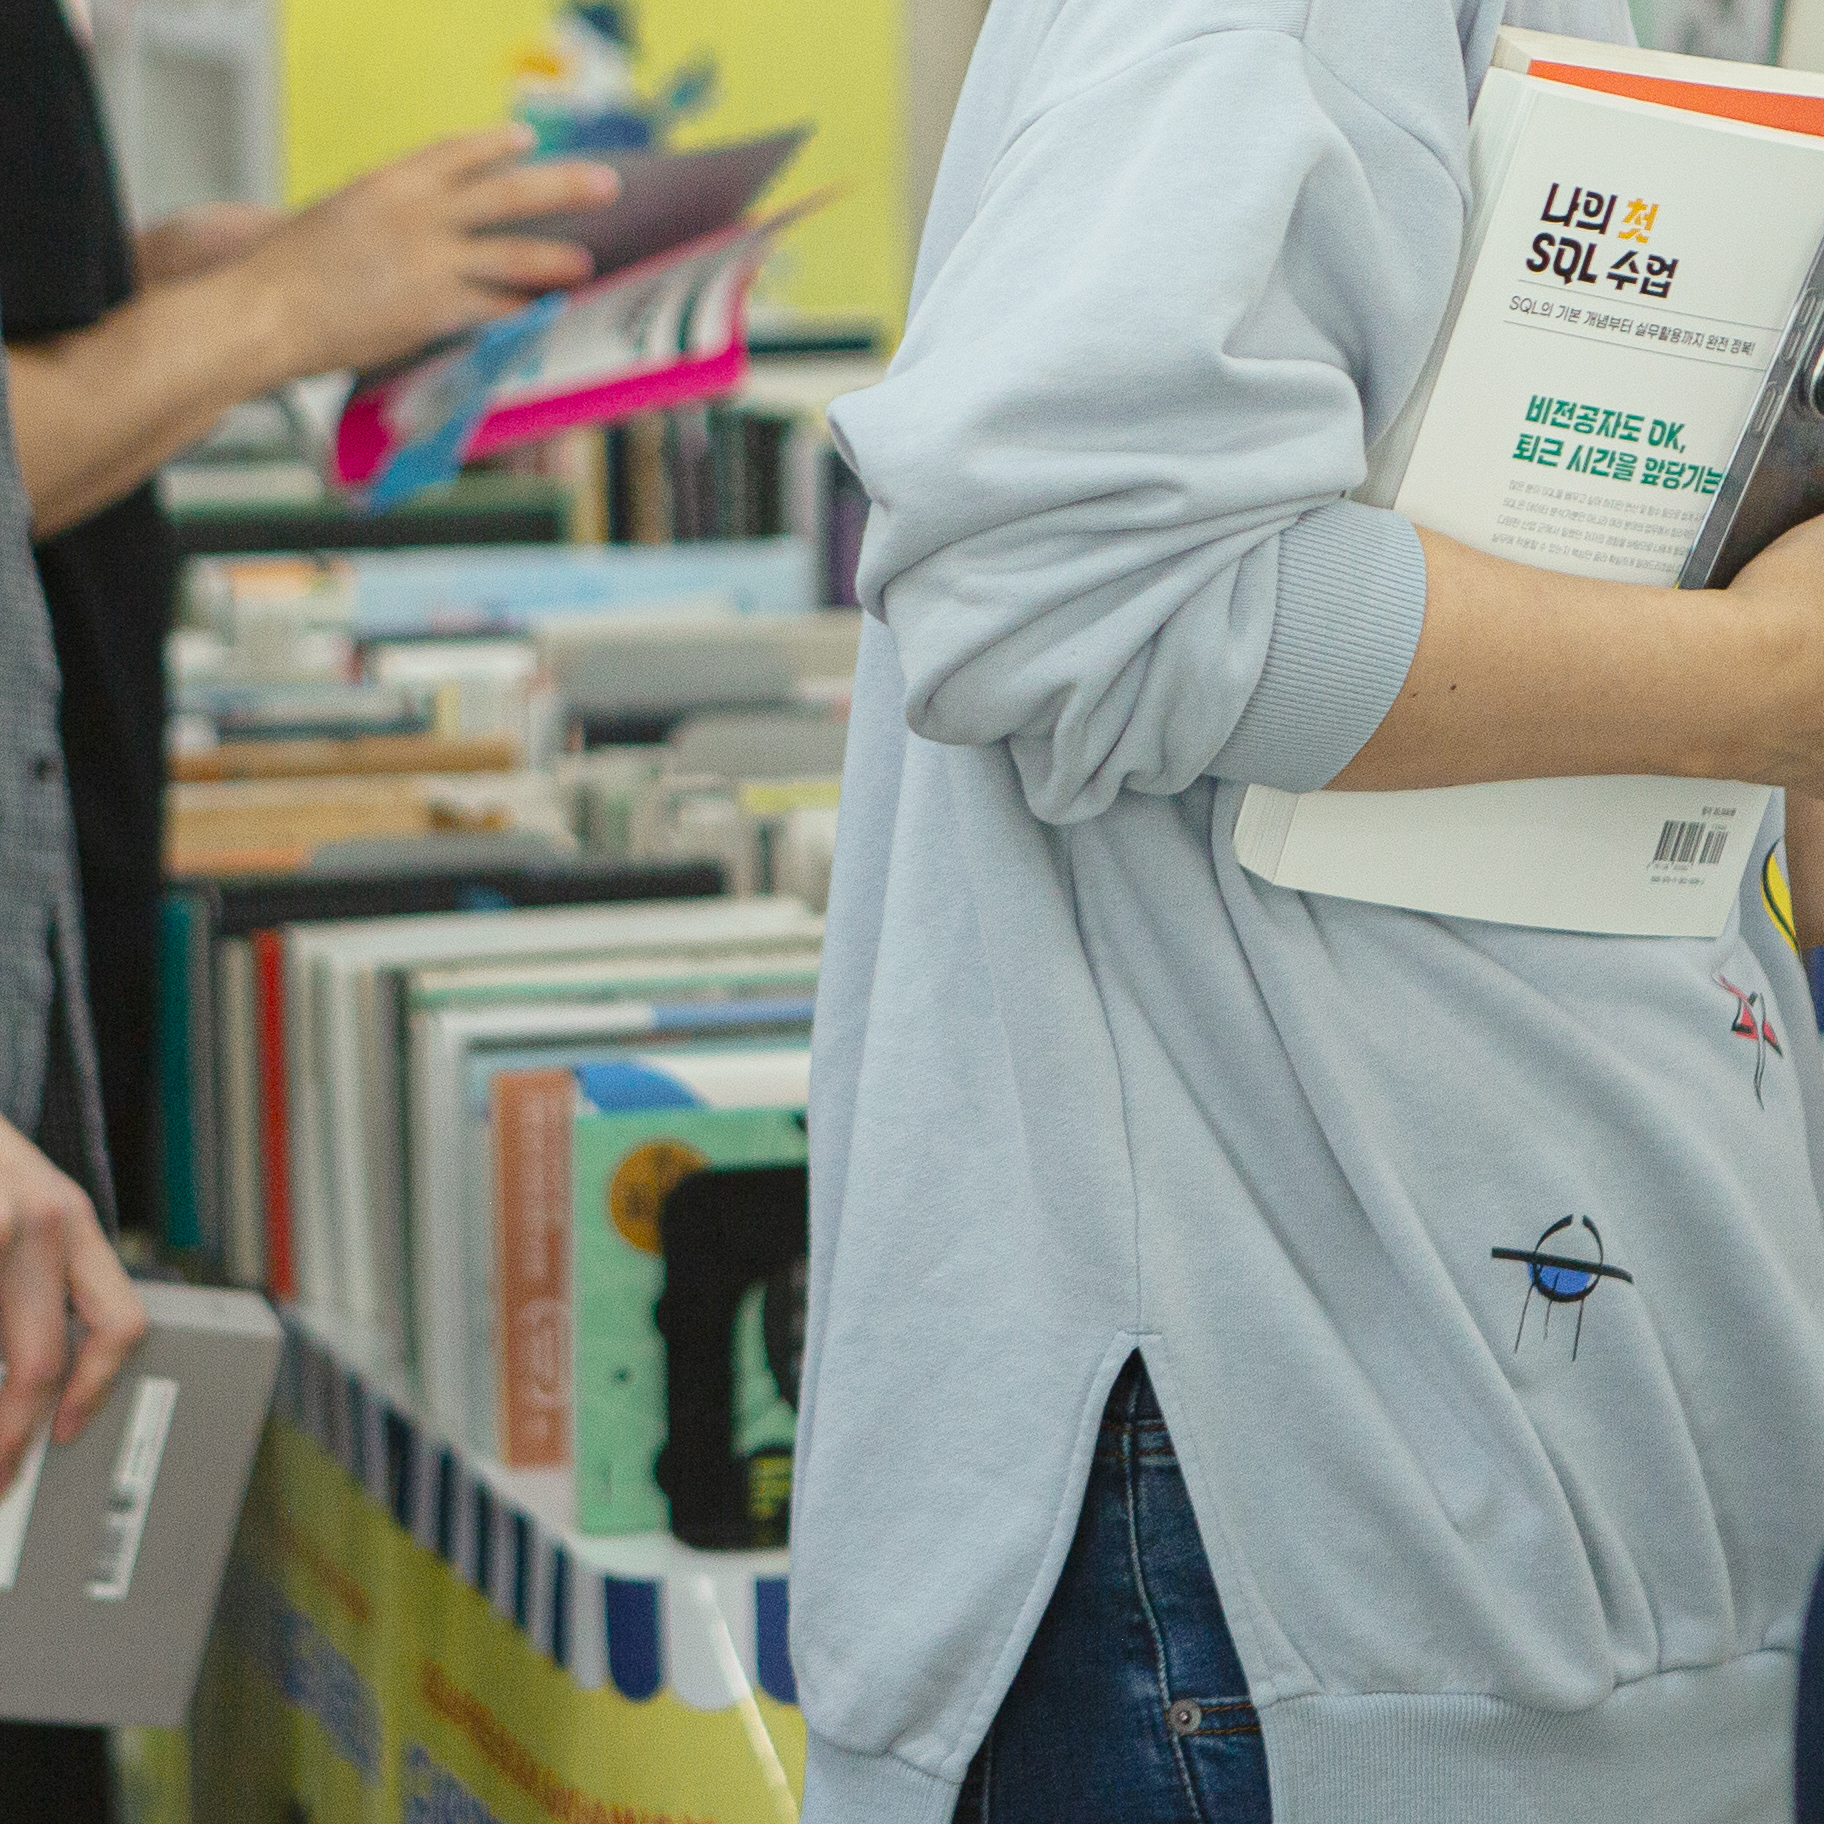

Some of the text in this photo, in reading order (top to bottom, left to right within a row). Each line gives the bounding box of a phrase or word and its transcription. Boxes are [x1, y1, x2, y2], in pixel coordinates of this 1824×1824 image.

[1540, 182, 1660, 244] 나의 첫
[1526, 232, 1679, 299] SQL 수업
[1509, 295, 1554, 317] SQL의
[1555, 304, 1582, 323] 기본
[1583, 311, 1633, 334] 개념부터
[1635, 322, 1704, 349] 실무활용까지
[1705, 335, 1730, 353] 완전
[1524, 394, 1686, 454] 비전공자도 OK,
[1512, 433, 1725, 495] 퇴근 시간을 앞당기는
